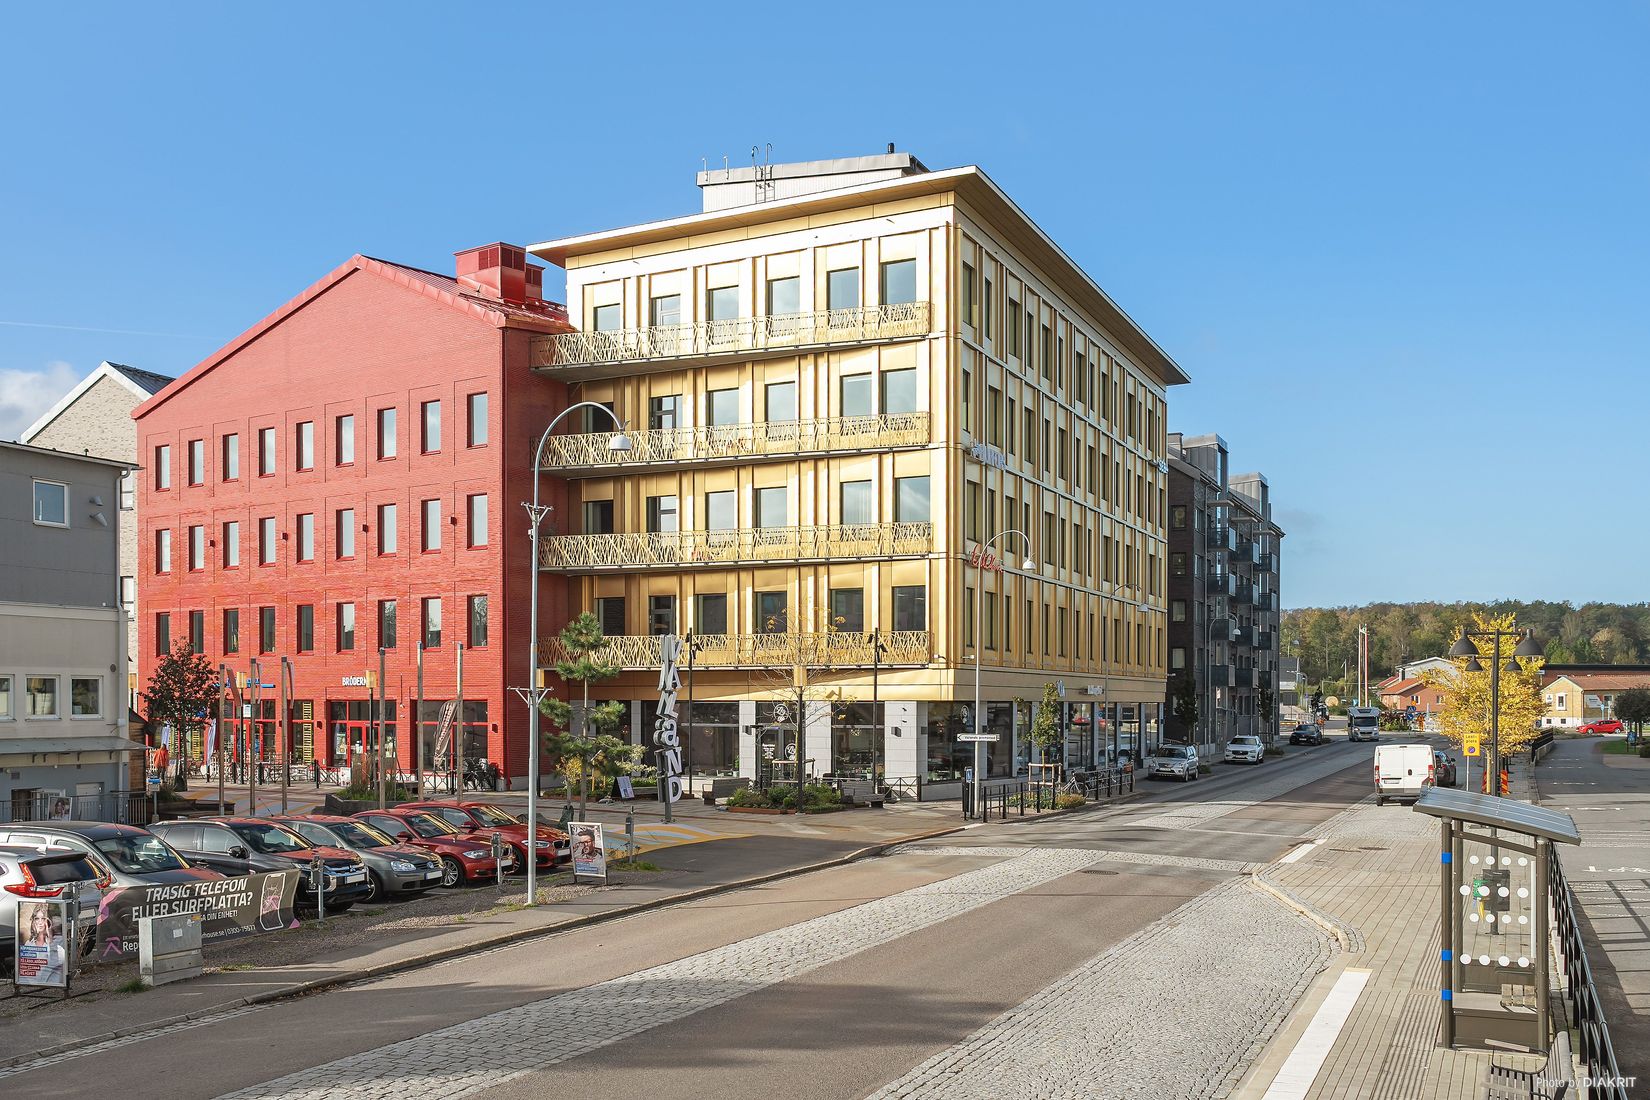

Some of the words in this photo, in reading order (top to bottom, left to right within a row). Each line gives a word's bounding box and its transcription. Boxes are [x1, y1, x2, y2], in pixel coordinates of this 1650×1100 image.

[146, 885, 191, 902] TRASIG
[195, 878, 248, 896] TELEFON
[132, 902, 169, 921] ELLER
[172, 892, 253, 914] SURFPLATTA?
[218, 910, 238, 919] ENHET!
[122, 941, 139, 952] Rep
